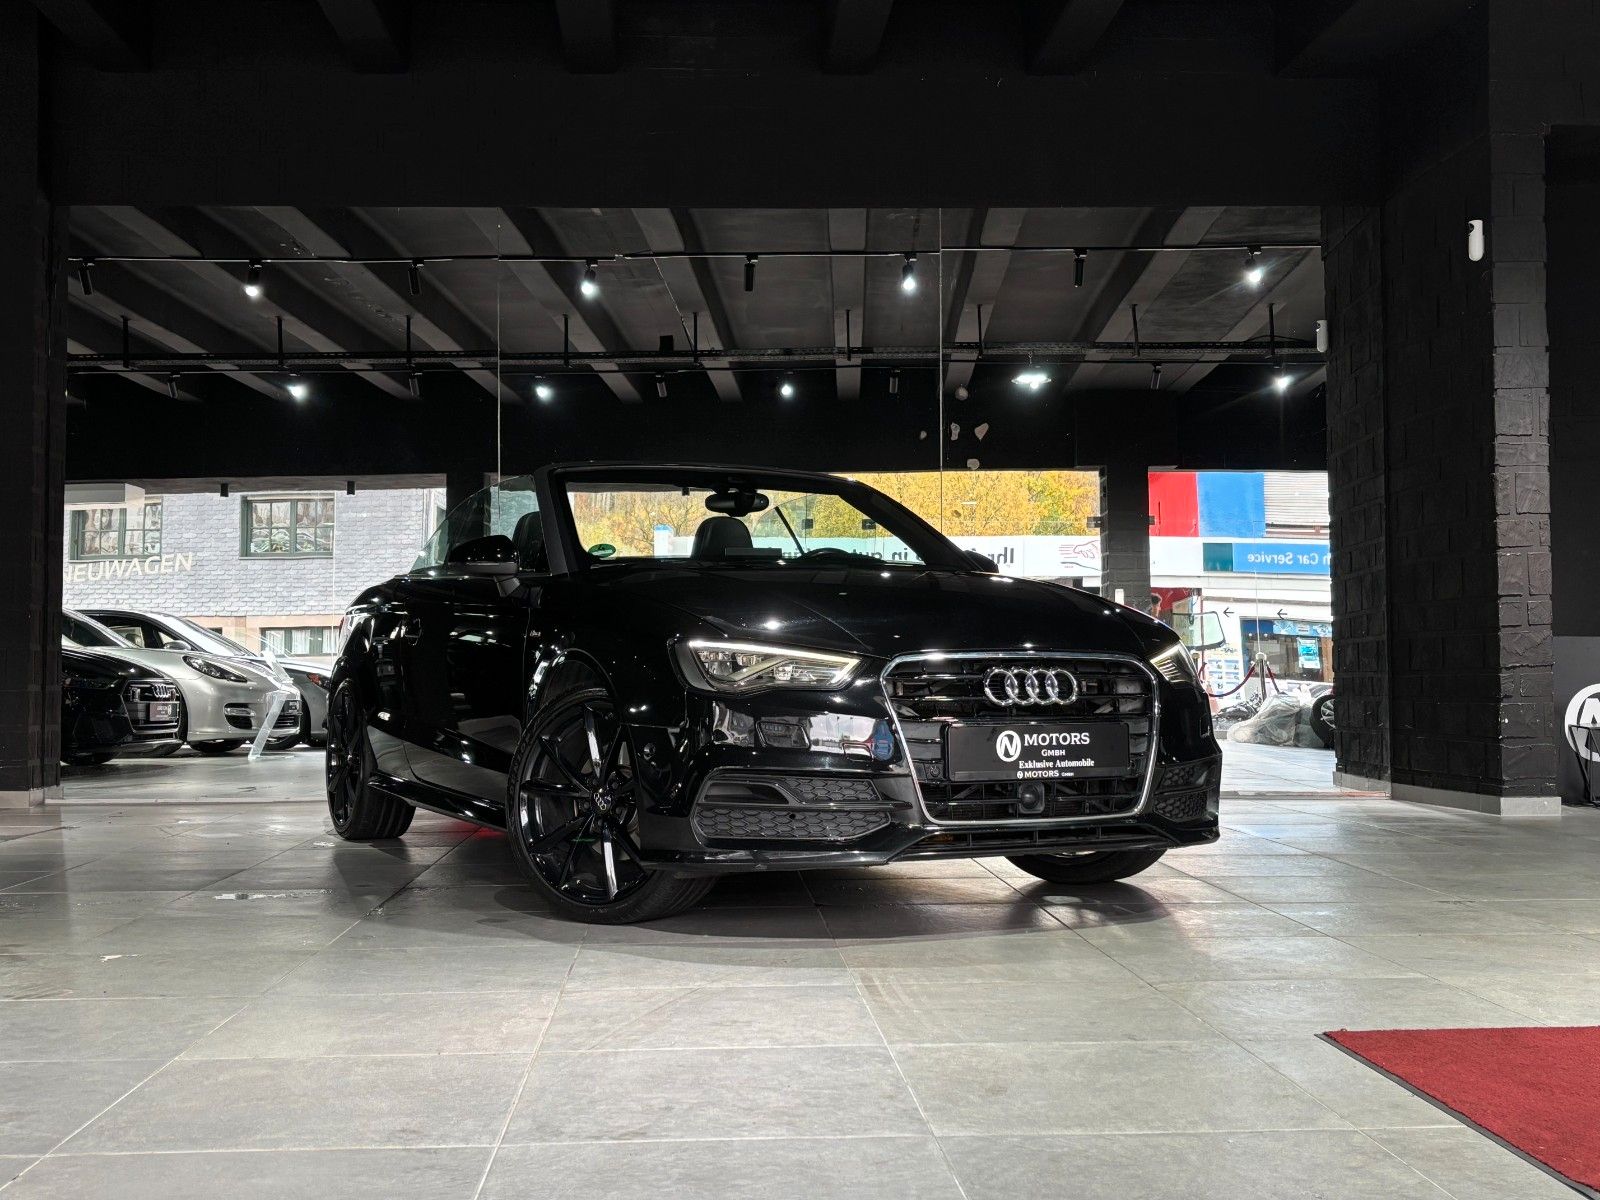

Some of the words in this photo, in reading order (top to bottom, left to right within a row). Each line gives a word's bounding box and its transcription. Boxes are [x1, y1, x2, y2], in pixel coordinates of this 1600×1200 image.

[1024, 732, 1090, 746] MOTORS
[1019, 760, 1054, 769] Exklusive
[1055, 758, 1095, 768] Automobile
[1024, 770, 1059, 778] MOTORS
